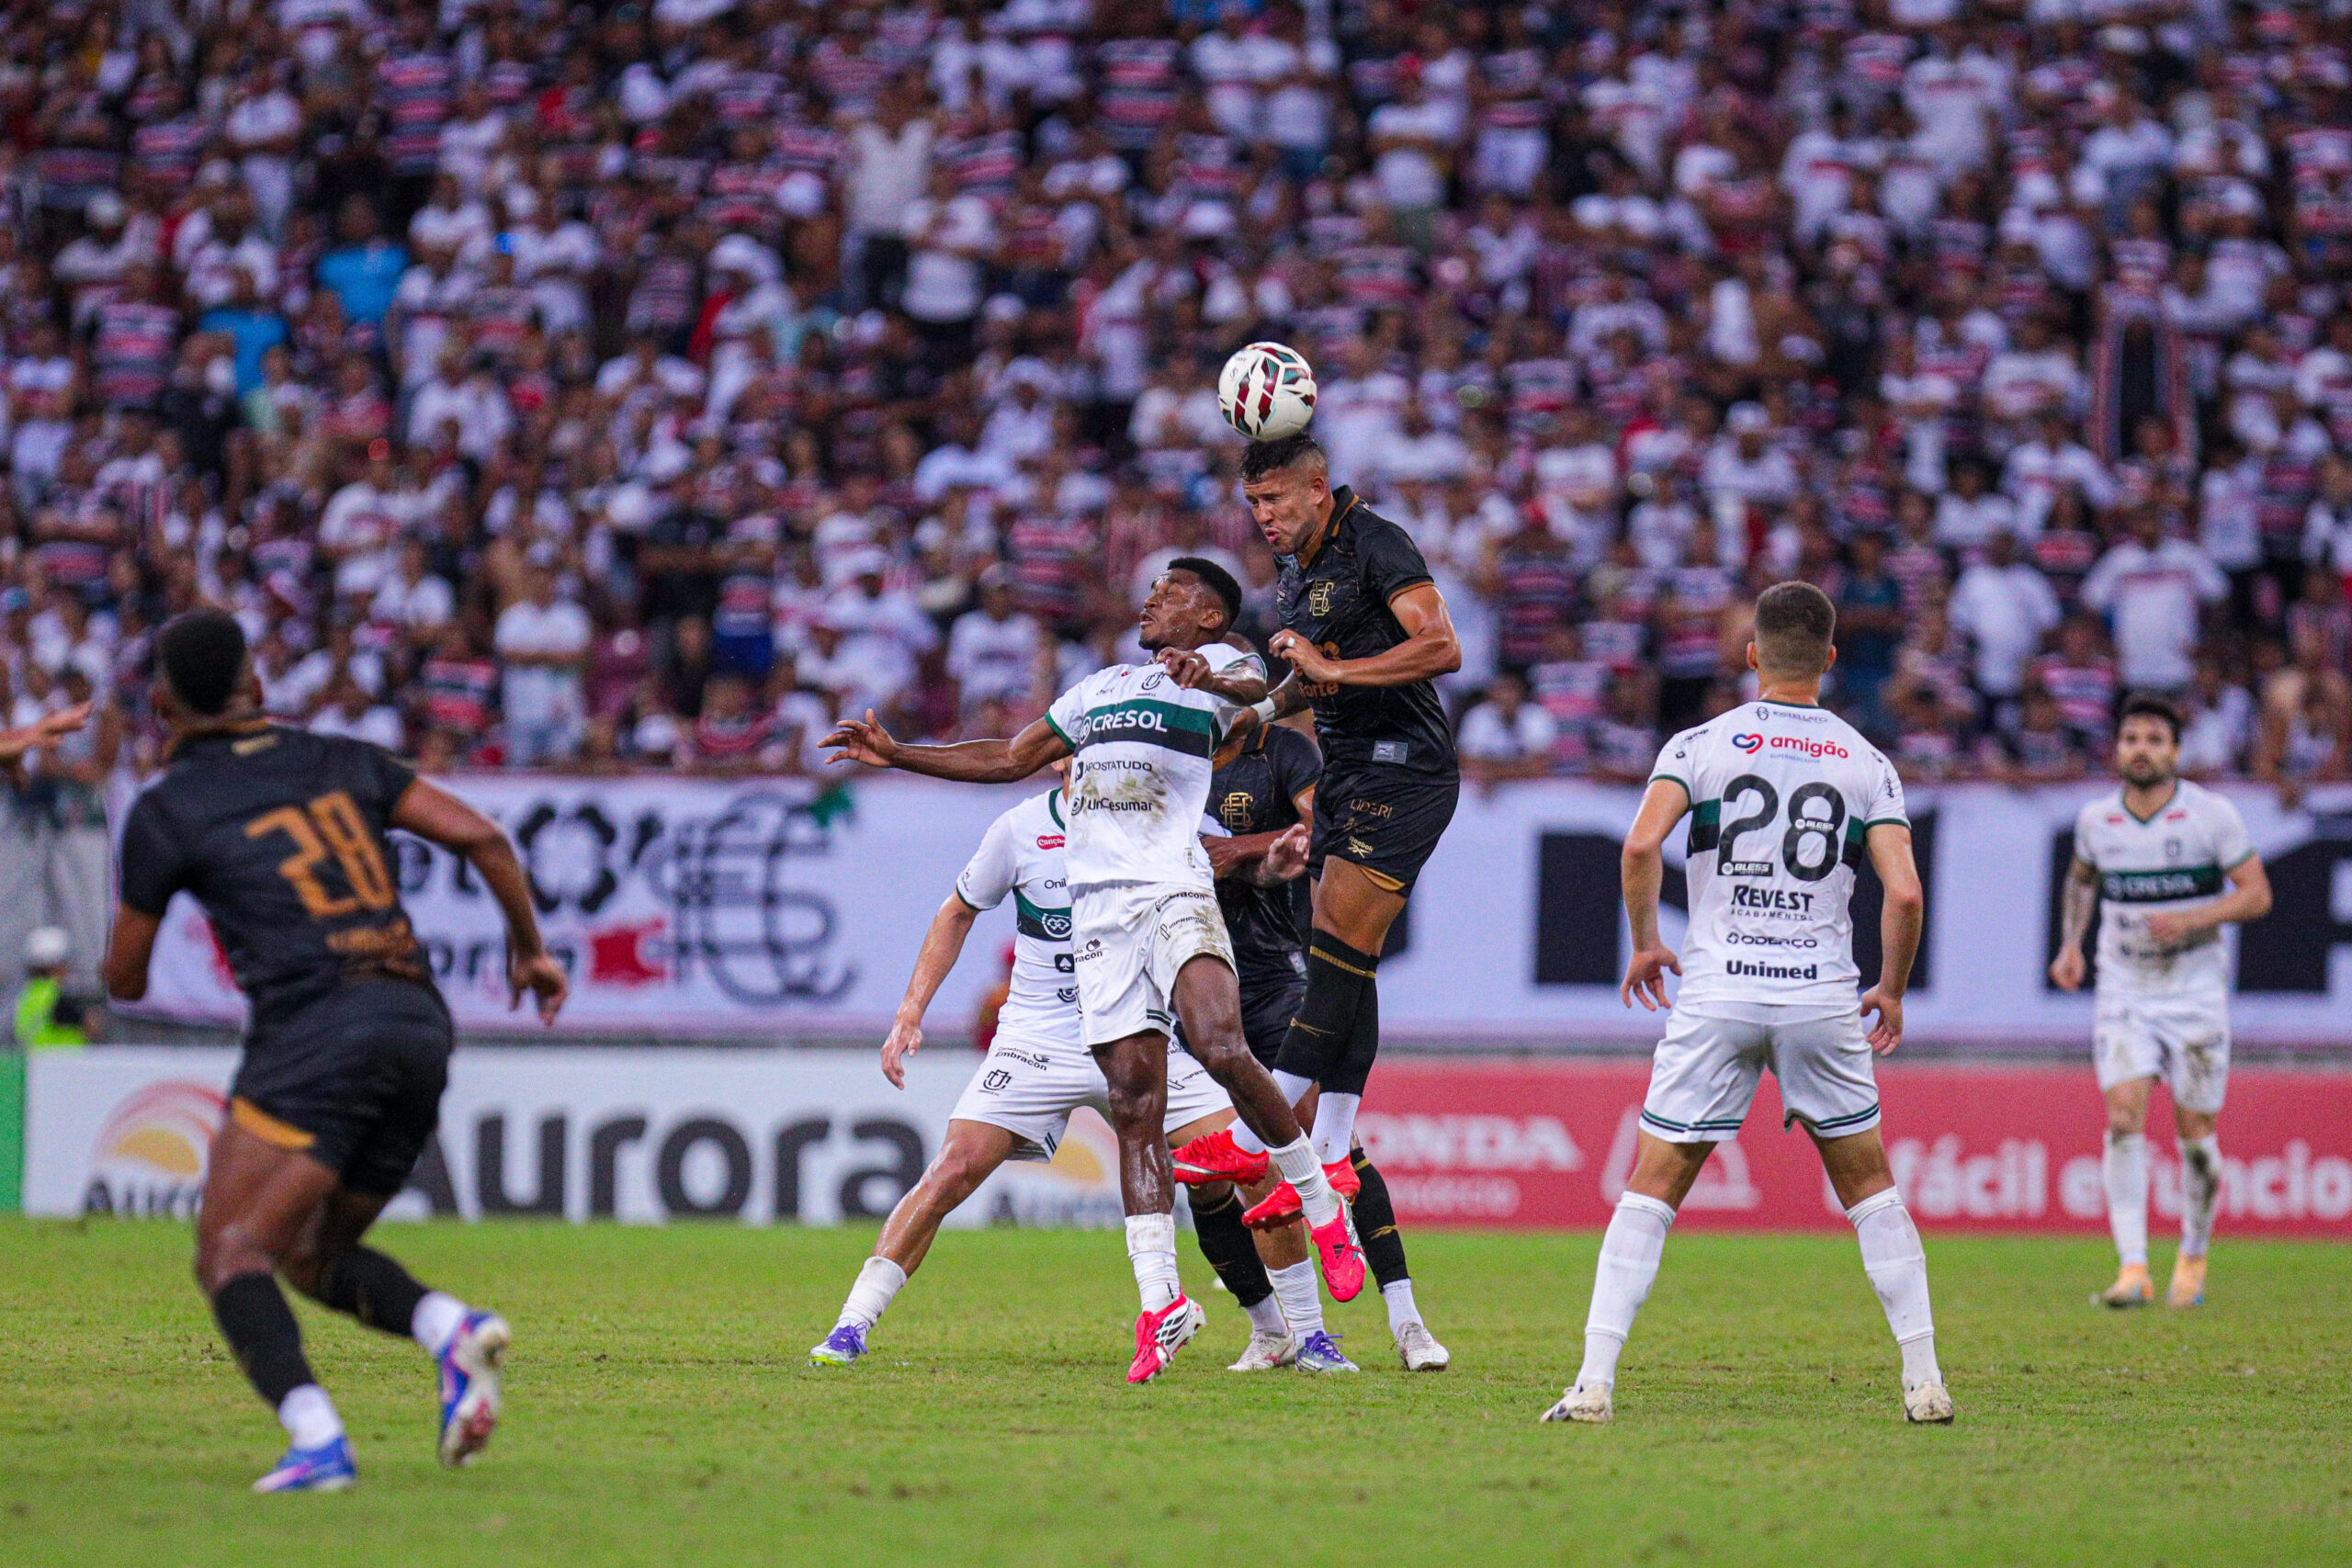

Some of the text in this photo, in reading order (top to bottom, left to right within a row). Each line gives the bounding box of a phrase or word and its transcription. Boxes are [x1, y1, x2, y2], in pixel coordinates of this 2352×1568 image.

[1092, 709, 1168, 733] CRESOL
[1770, 736, 1849, 759] amigão
[1085, 761, 1153, 773] APOSTATUDO
[1717, 773, 1845, 881] 28
[1805, 820, 1835, 830] BLESS
[243, 789, 393, 917] 28
[1349, 835, 1374, 852] Reebok
[1734, 863, 1770, 873] BLESS
[1731, 885, 1815, 912] REVEST
[1726, 960, 1817, 980] Unimed
[995, 1050, 1047, 1072] Embracon
